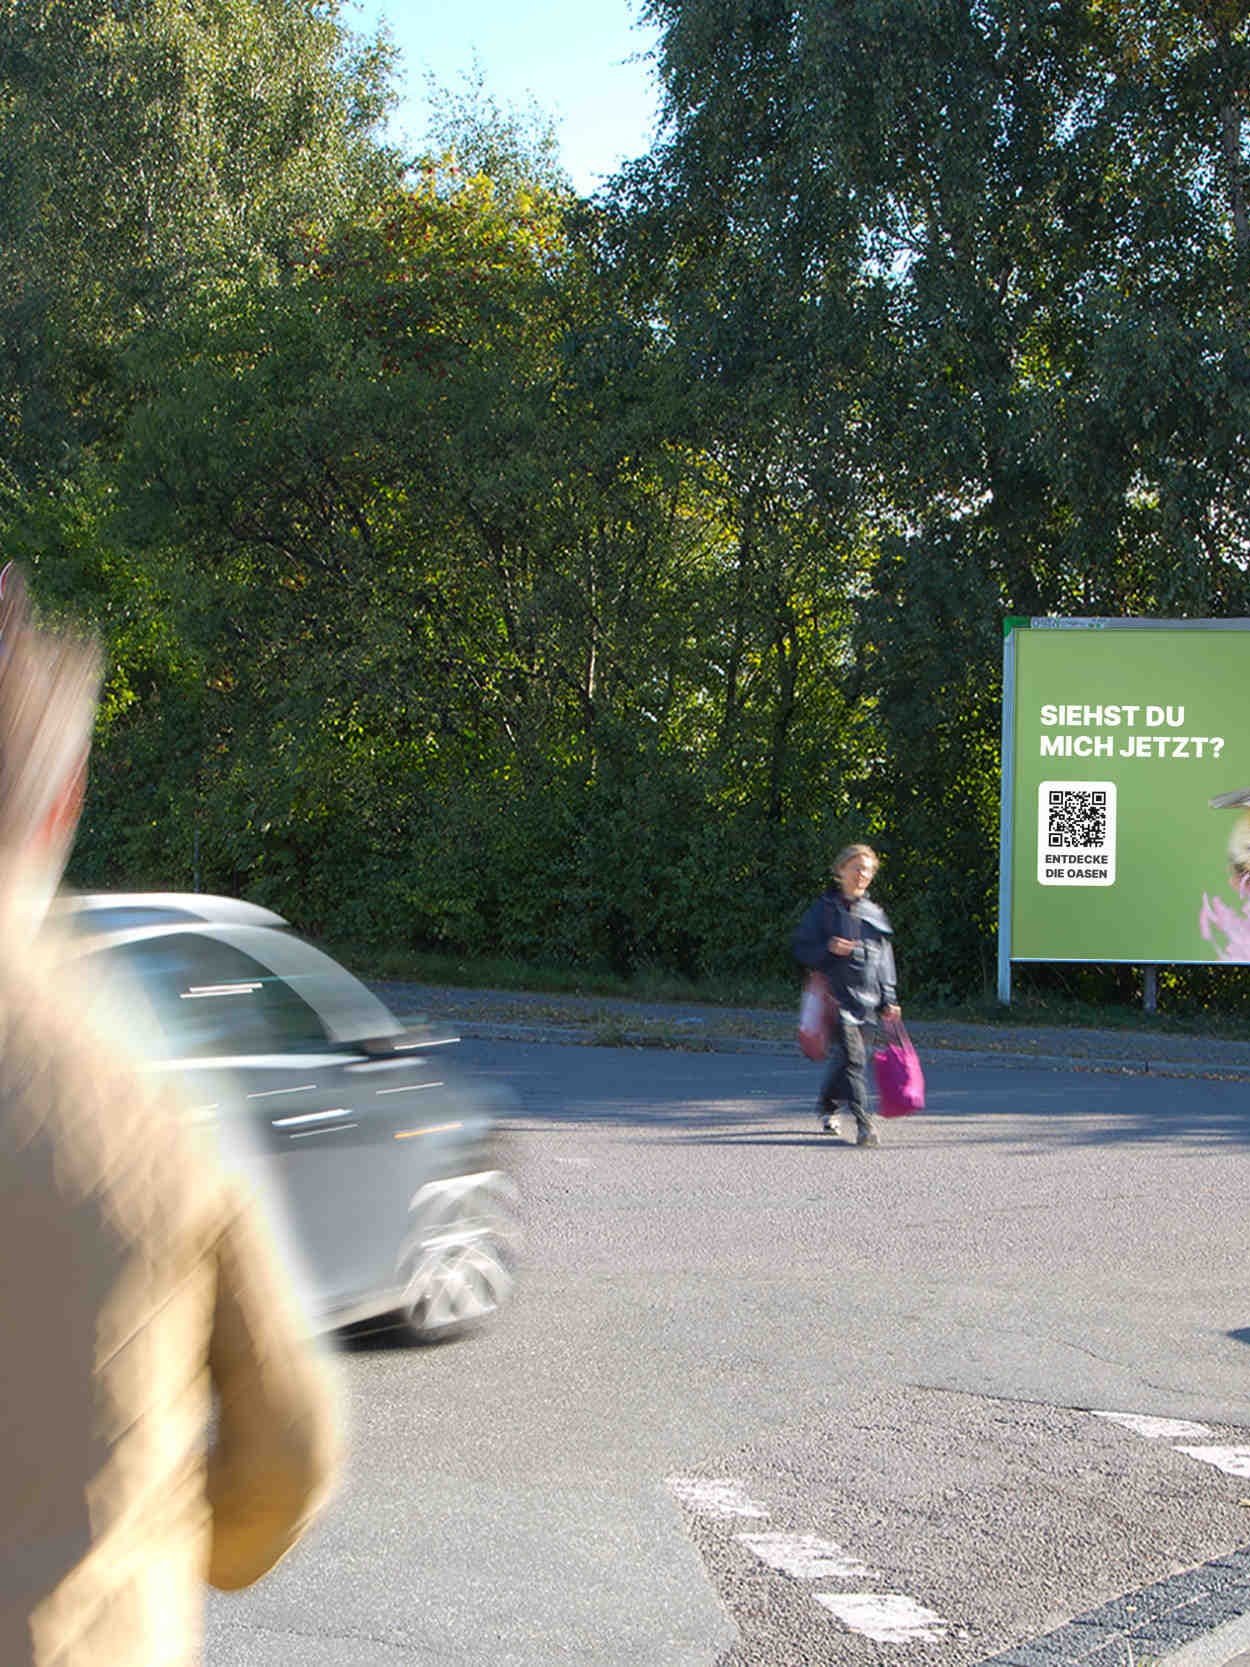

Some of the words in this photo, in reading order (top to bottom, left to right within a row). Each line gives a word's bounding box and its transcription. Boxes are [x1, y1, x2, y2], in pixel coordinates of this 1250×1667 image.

[1039, 704, 1140, 727] SIEHST
[1145, 705, 1185, 728] DU
[1039, 735, 1114, 757] MICH
[1119, 736, 1225, 759] JETZT?
[1045, 854, 1109, 865] ENTDECKE
[1045, 868, 1065, 879] DIE
[1067, 868, 1108, 879] OASEN
